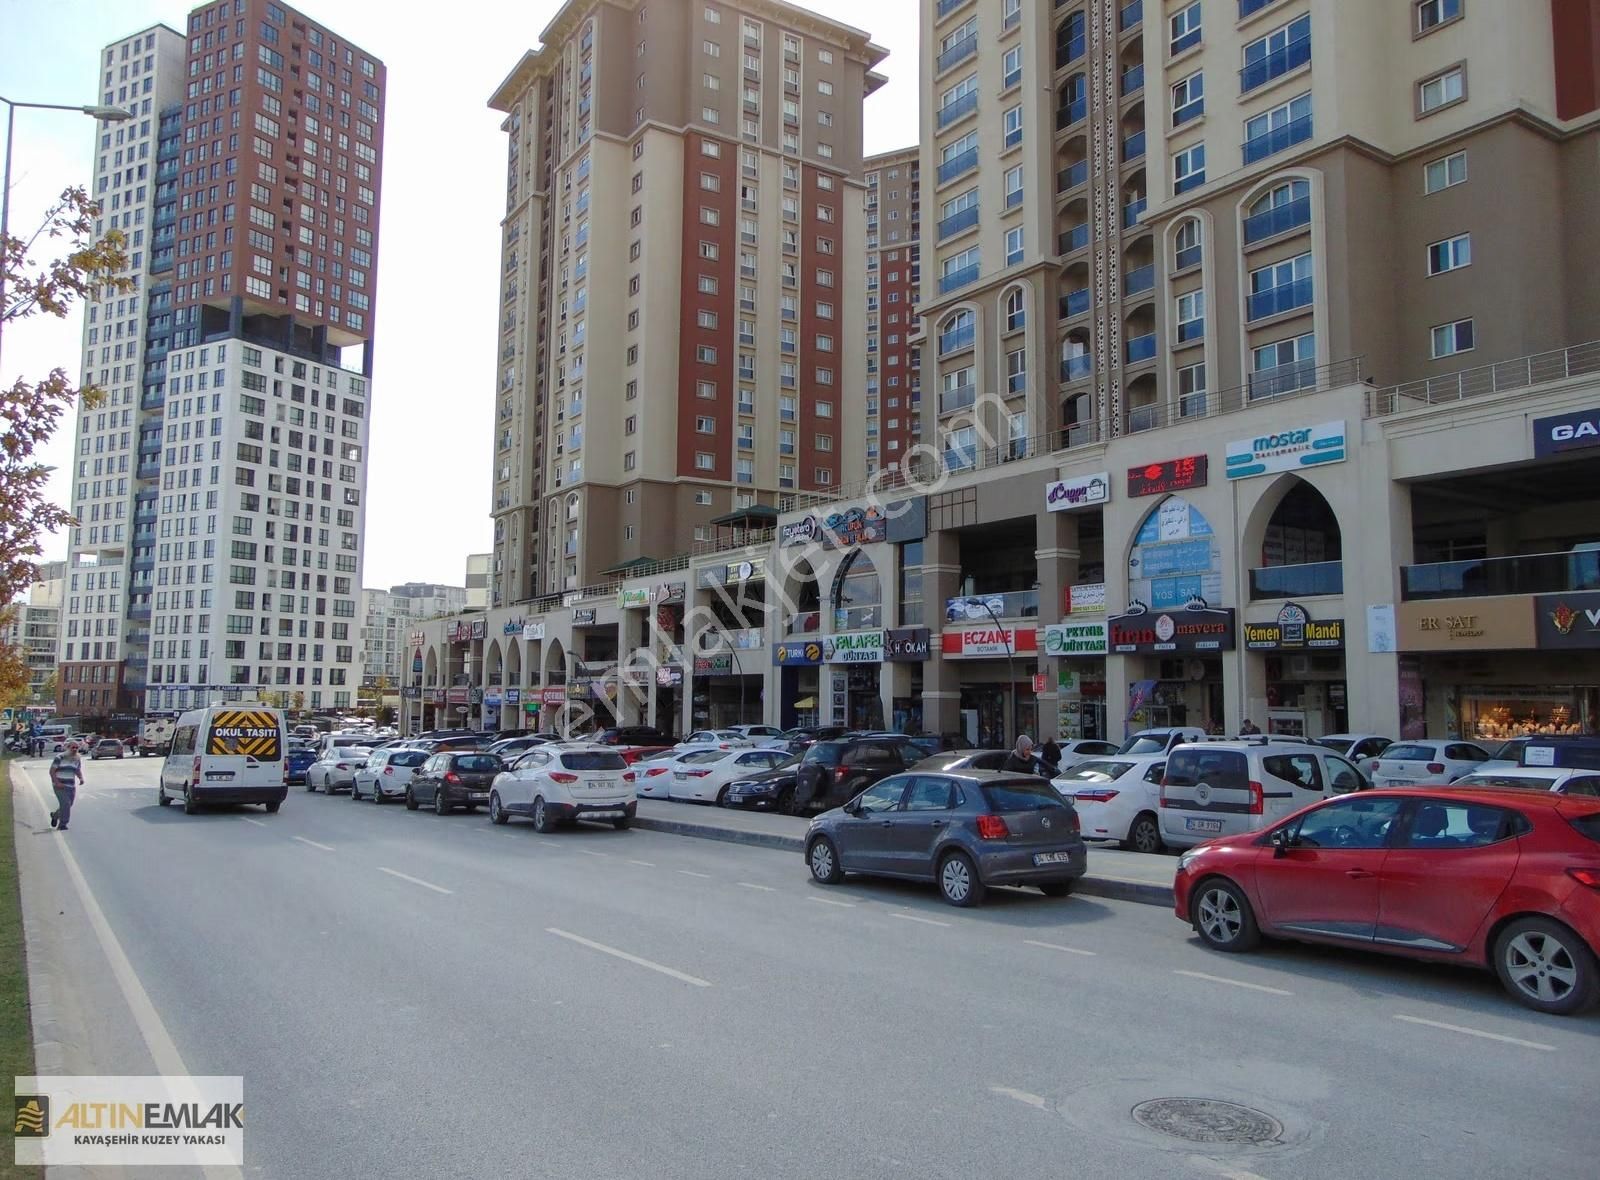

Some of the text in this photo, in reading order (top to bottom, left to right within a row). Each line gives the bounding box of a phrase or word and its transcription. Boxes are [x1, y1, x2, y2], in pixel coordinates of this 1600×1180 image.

[1253, 427, 1313, 452] mostar
[1551, 421, 1600, 441] GA
[964, 629, 1012, 645] ECZANE
[1176, 622, 1225, 635] mavera
[1244, 625, 1280, 641] Yemen
[1305, 622, 1341, 639] Mandi
[835, 633, 883, 650] FALAFEL
[215, 728, 277, 738] OKUL TAŞITI
